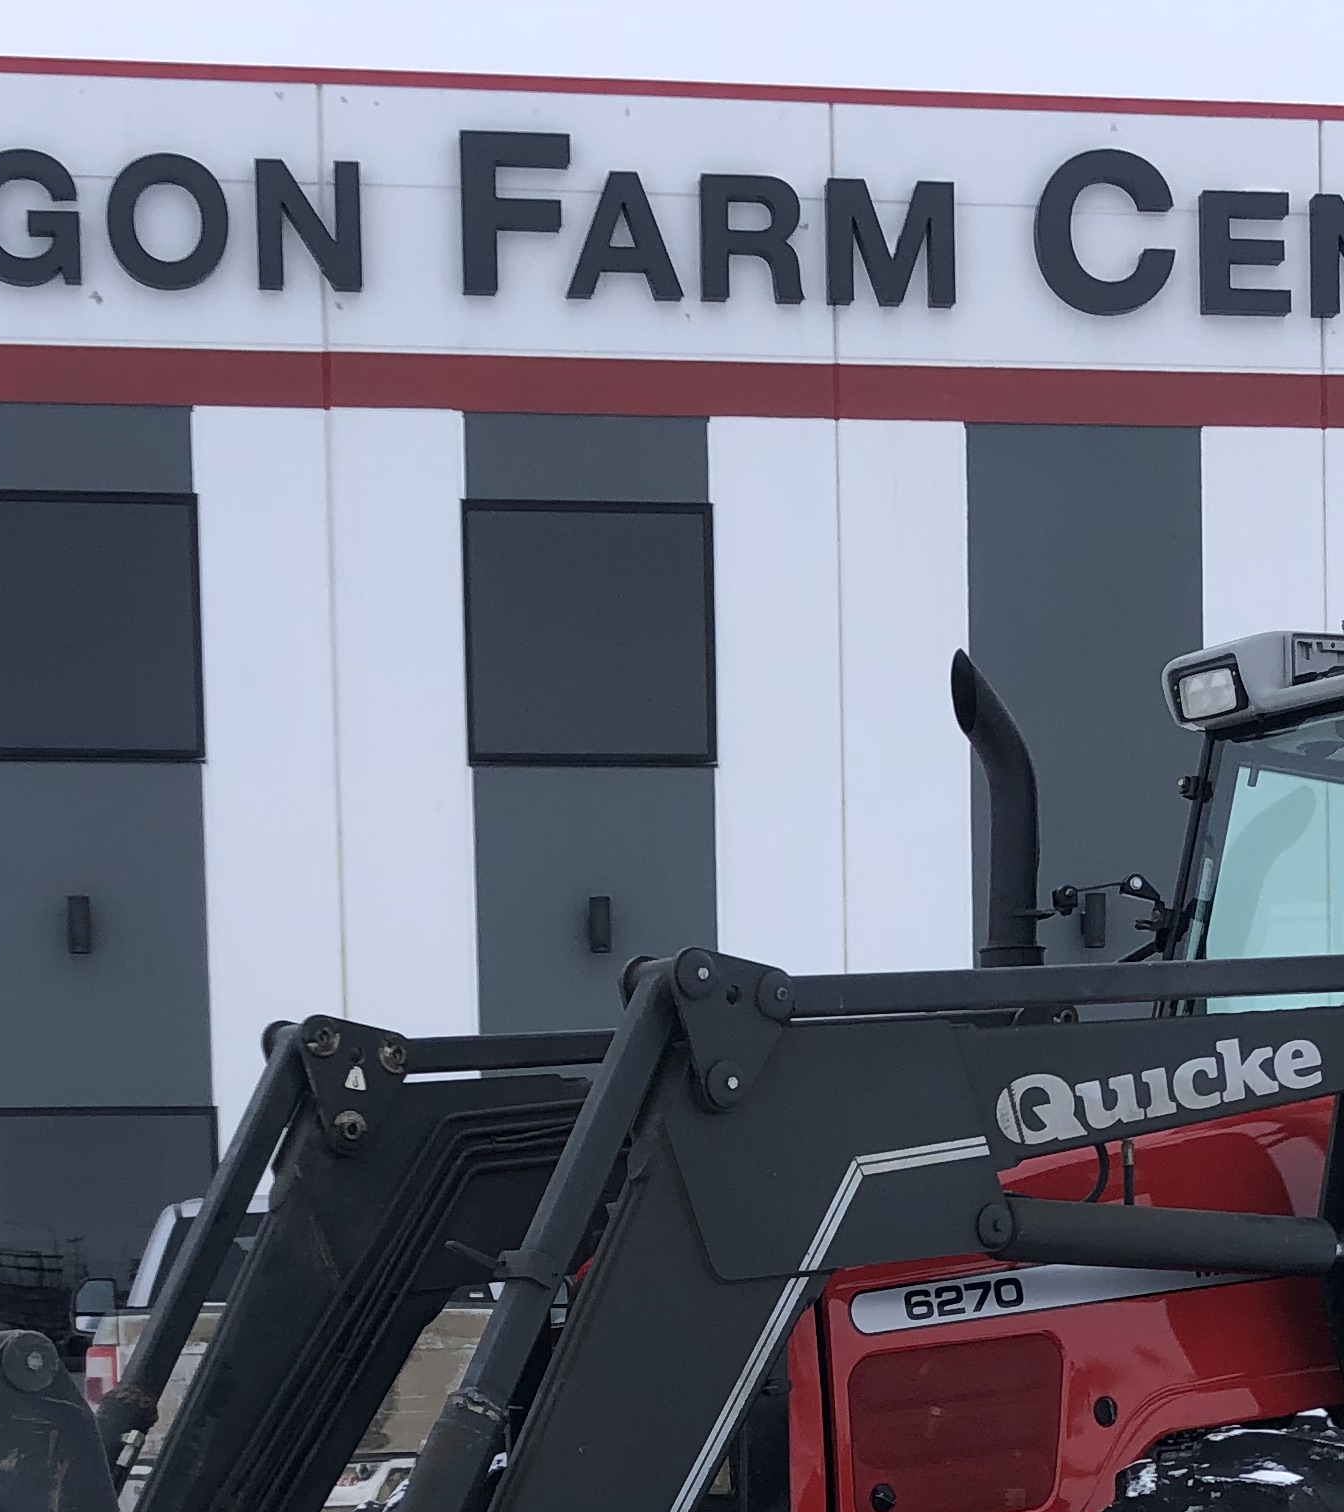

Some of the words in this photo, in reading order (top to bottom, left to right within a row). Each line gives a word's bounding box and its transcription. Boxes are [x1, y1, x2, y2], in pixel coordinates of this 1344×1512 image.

[458, 129, 958, 310] FARM
[996, 1037, 1323, 1145] Quicke
[903, 1277, 1024, 1321] 6270
